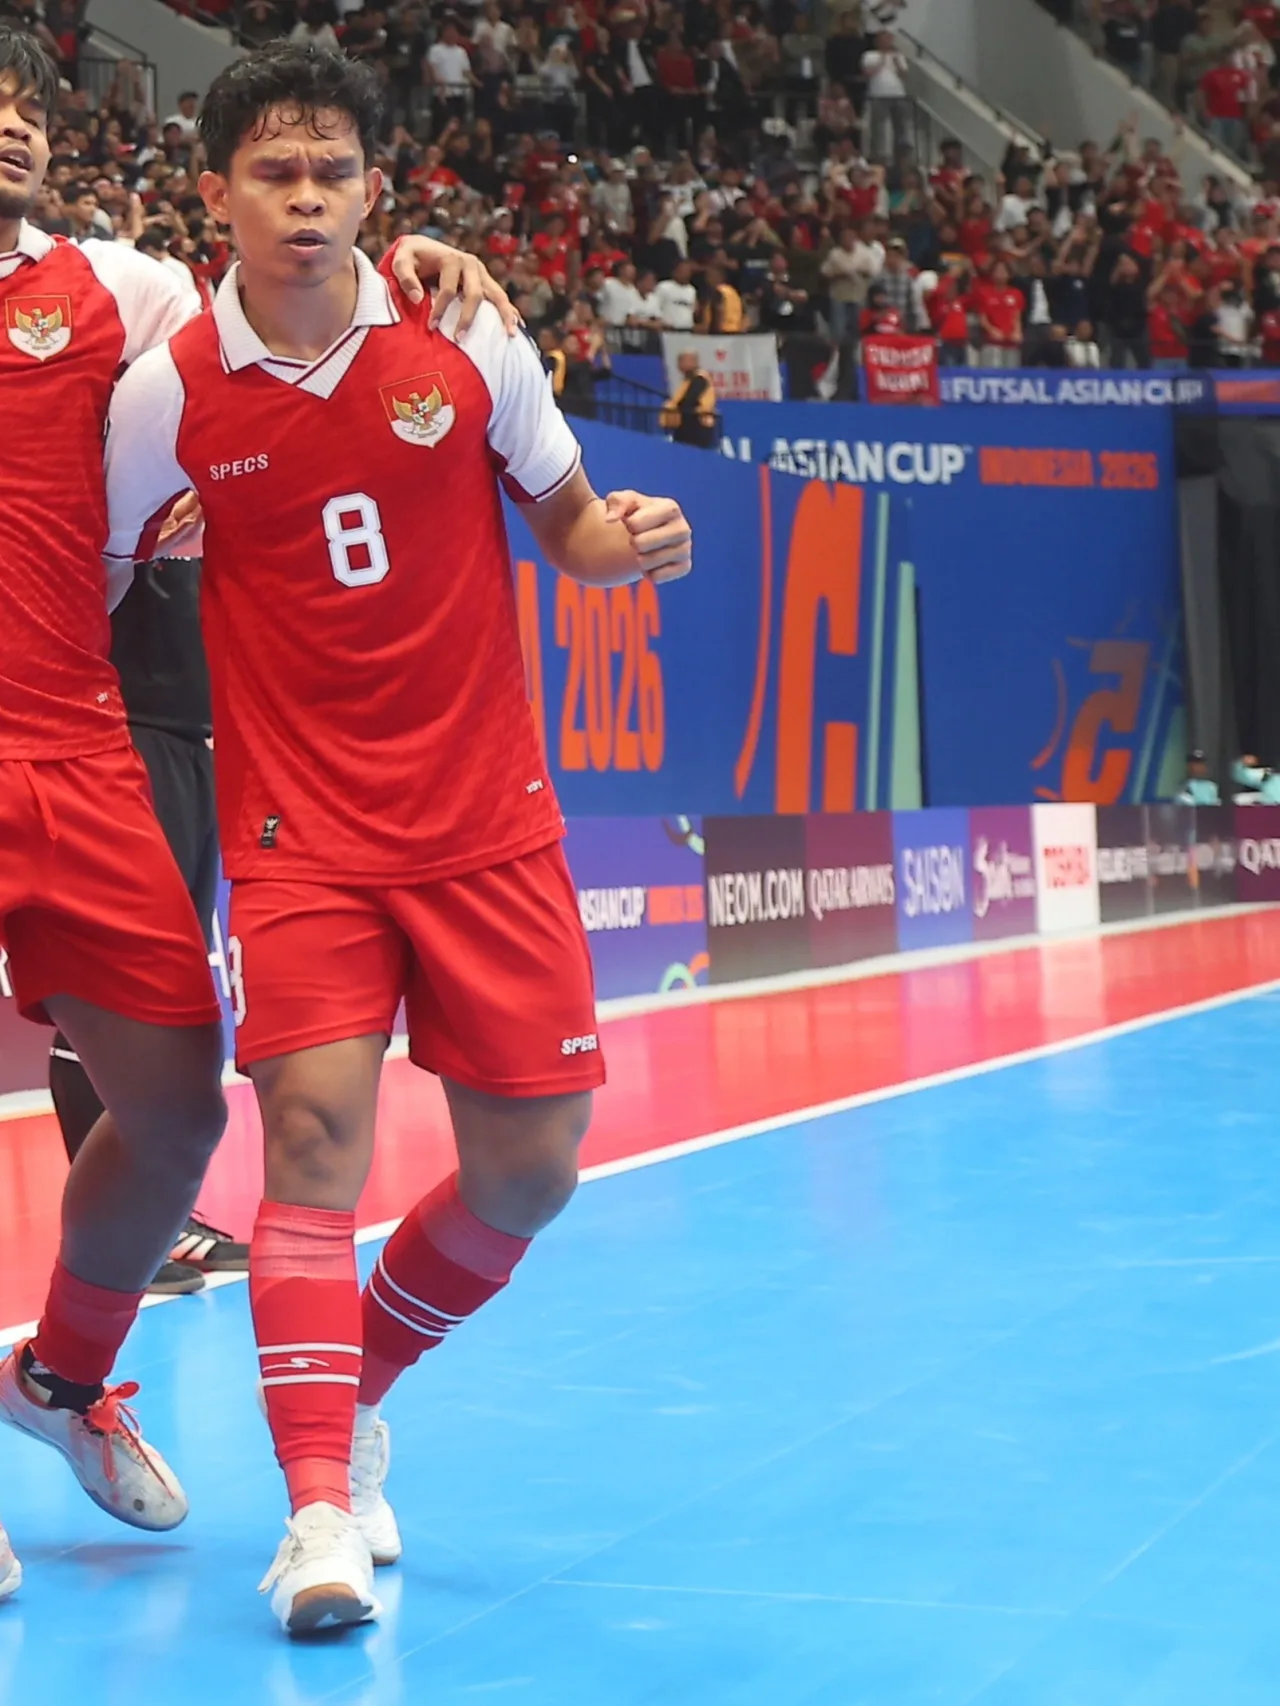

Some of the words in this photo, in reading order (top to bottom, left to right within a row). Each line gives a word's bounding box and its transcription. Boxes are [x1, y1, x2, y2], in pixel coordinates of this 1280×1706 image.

[953, 377, 1053, 404] FUTSAL
[209, 453, 270, 482] SPECS
[322, 492, 391, 588] 8
[554, 572, 665, 772] 2026
[708, 867, 805, 927] NEOM.COM
